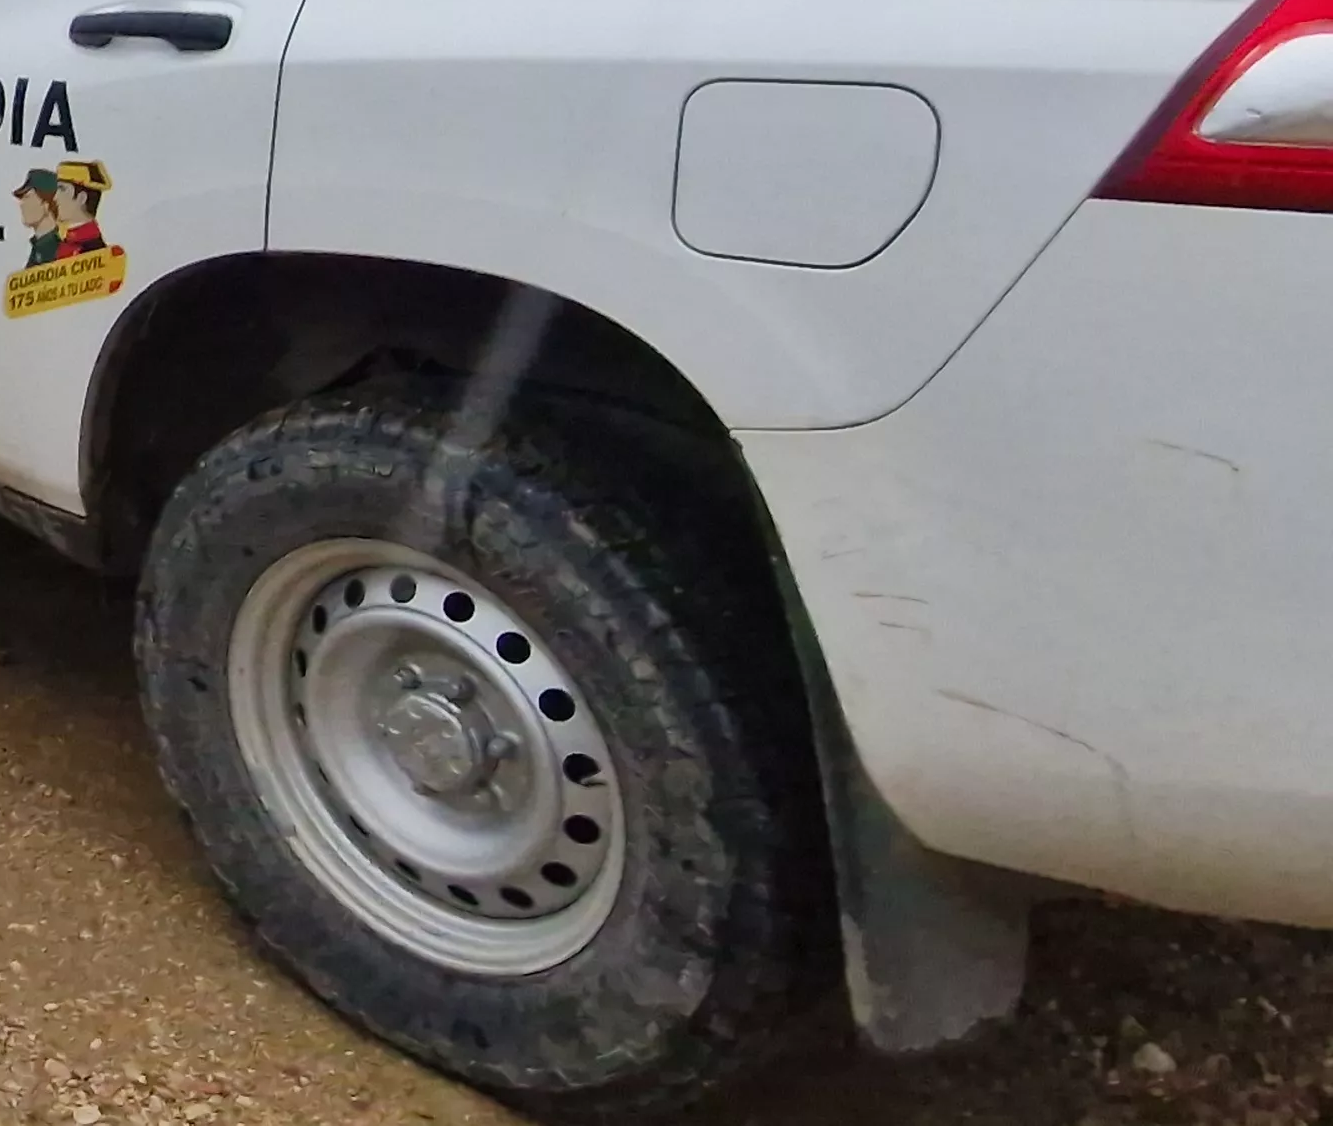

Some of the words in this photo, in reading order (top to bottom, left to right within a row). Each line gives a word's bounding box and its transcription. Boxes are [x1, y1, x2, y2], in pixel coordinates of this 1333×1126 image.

[9, 265, 67, 291] GUARDIA
[71, 256, 106, 276] CIVIL
[9, 291, 34, 311] 175
